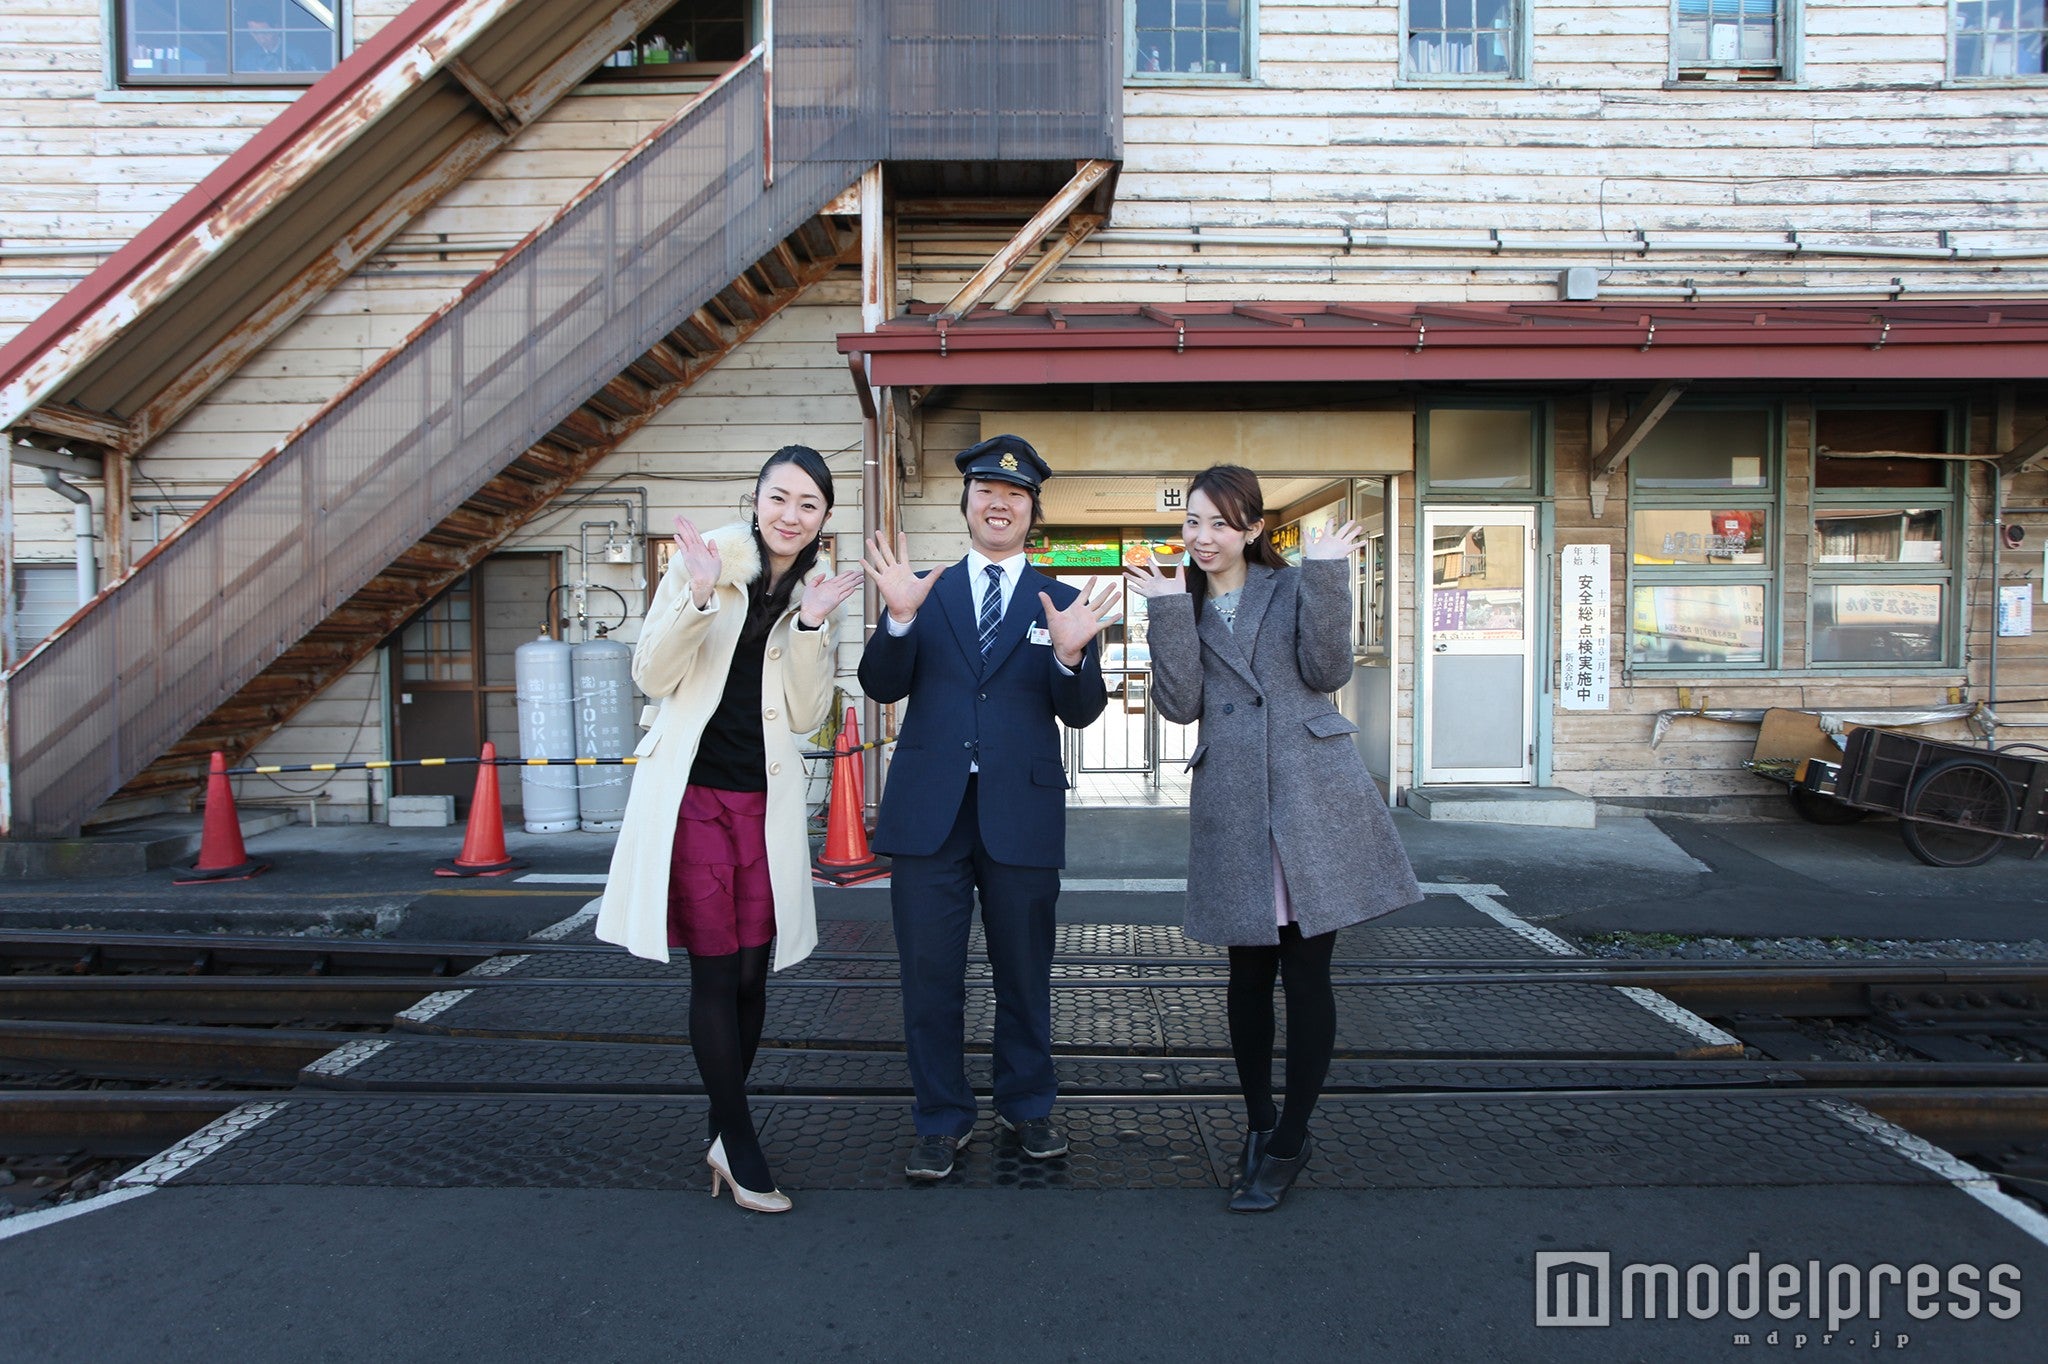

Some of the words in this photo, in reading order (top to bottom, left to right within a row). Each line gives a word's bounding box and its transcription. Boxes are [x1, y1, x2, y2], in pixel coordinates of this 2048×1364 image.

[1573, 546, 1583, 565] 年始
[1589, 546, 1599, 566] 年末
[1577, 575, 1593, 702] 安全総点検実施中
[1564, 653, 1574, 691] 新金谷駅
